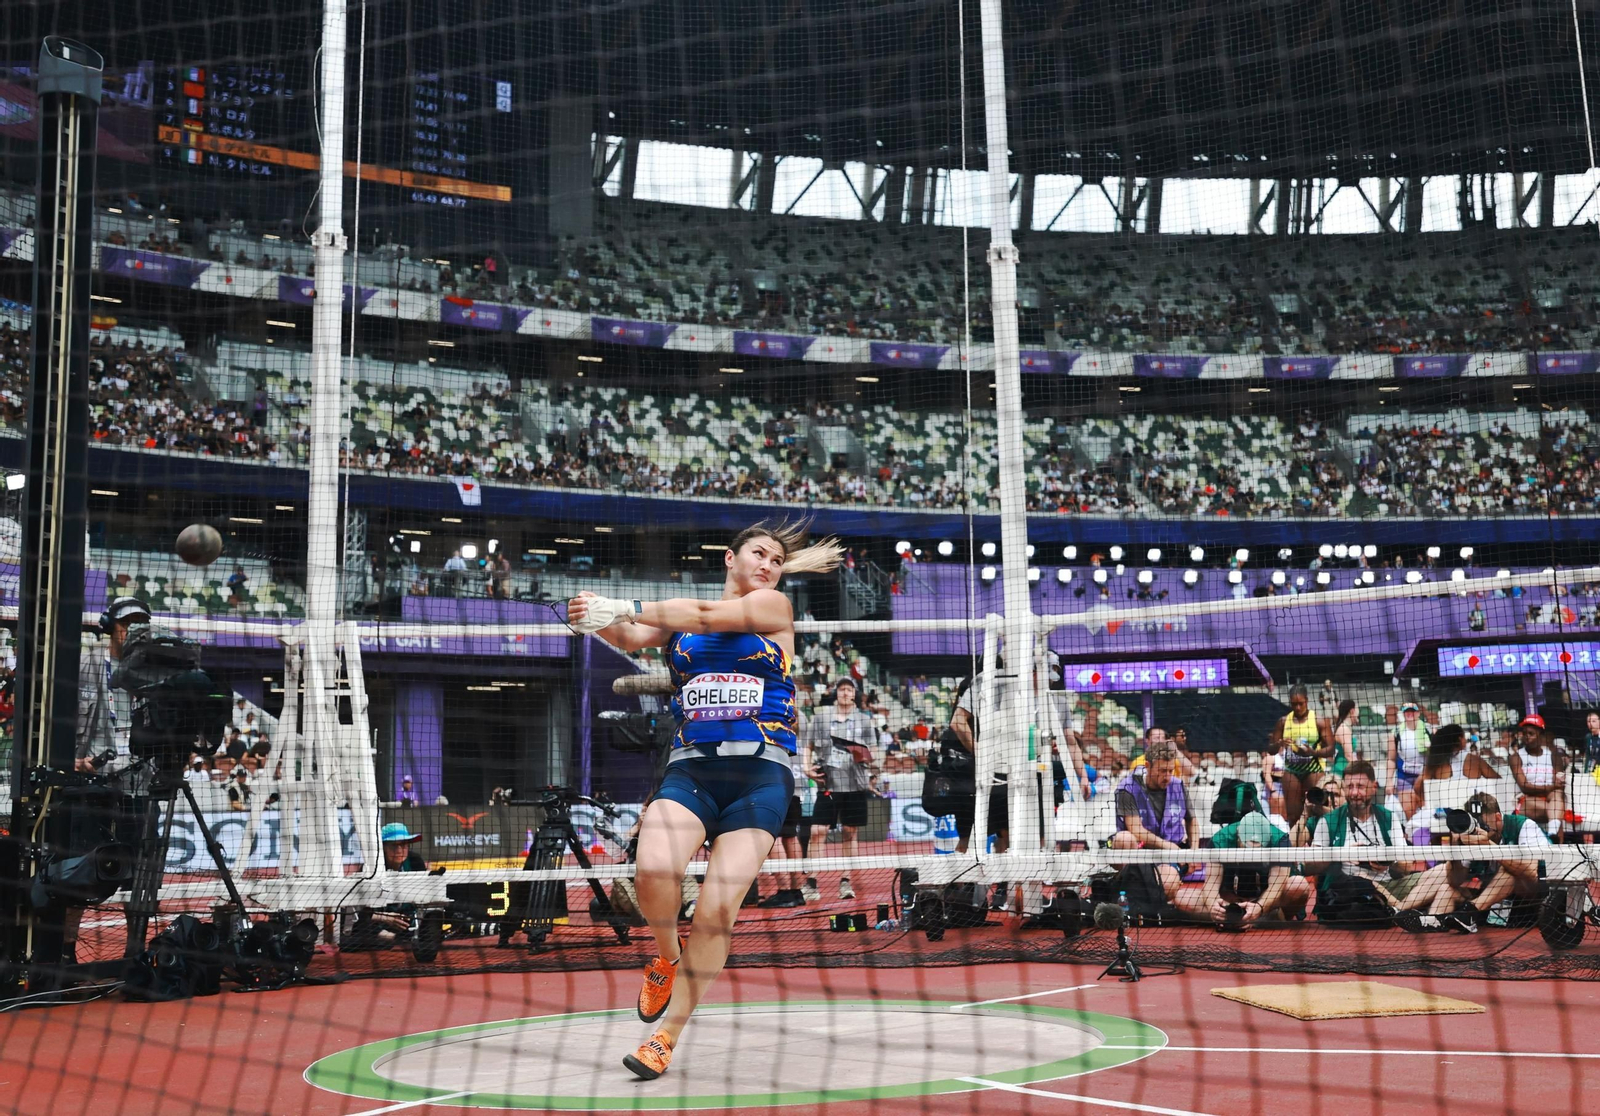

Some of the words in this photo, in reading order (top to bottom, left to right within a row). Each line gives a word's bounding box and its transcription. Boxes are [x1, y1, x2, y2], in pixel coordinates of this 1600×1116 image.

[687, 689, 758, 706] GHELBER
[434, 833, 501, 847] HAWK-EYE
[486, 881, 510, 916] 3
[647, 970, 669, 987] NIKE
[647, 1040, 667, 1058] NIKE
